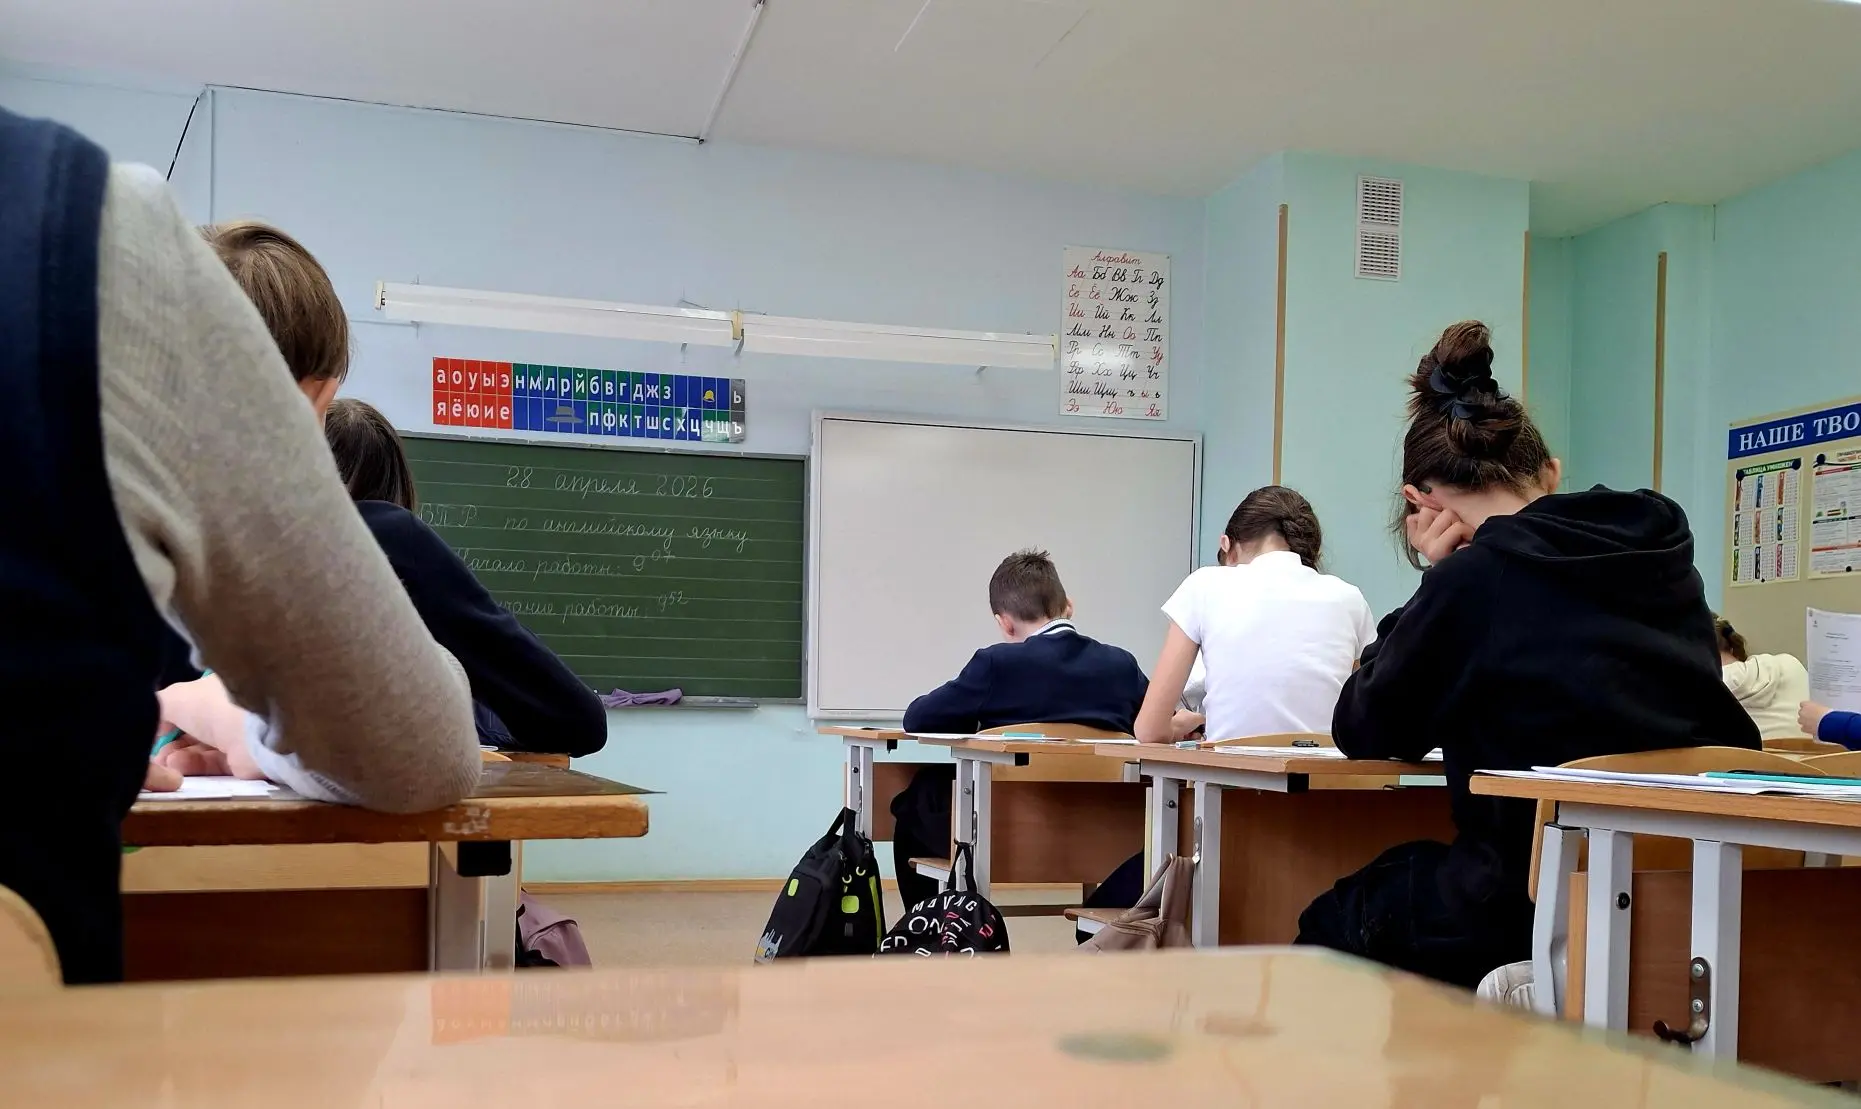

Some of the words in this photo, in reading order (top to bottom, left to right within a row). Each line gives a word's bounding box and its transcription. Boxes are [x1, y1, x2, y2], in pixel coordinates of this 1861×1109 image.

[1091, 251, 1141, 265] Алфавит
[1739, 422, 1805, 451] НАШЕ
[1813, 411, 1861, 437] ТВО
[506, 466, 533, 488] 28
[555, 472, 640, 499] апреля
[656, 475, 715, 498] 2026
[504, 517, 528, 530] по
[543, 517, 675, 549] английскому
[687, 527, 749, 553] языку
